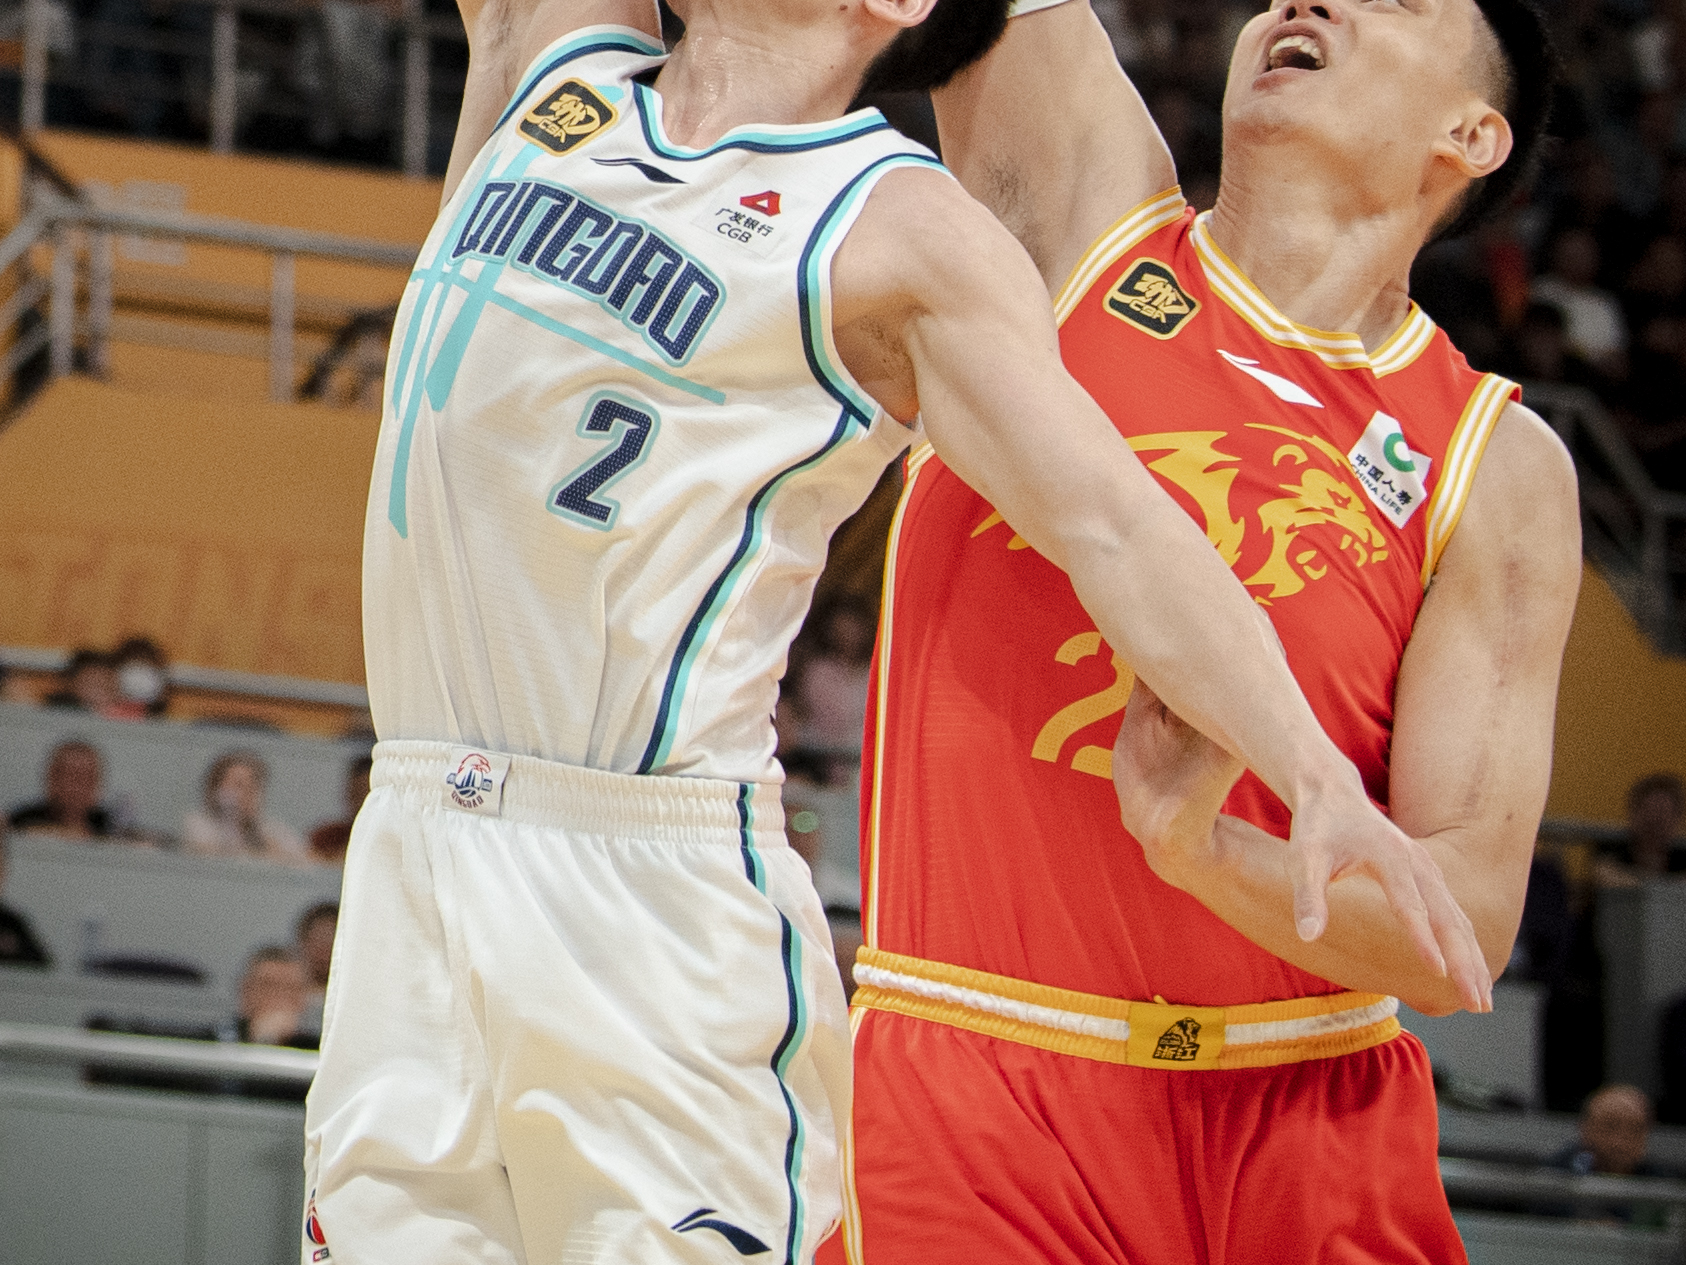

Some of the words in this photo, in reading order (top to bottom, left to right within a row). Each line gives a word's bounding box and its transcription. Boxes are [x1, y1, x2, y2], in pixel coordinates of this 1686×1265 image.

[538, 117, 567, 144] CBA
[715, 207, 774, 238] 广发银行
[716, 223, 753, 244] CGB
[452, 179, 723, 364] QINGDAO
[1129, 299, 1167, 324] CBA
[548, 392, 658, 528] 2
[1355, 453, 1413, 506] 中国人寿
[1380, 493, 1403, 515] LIFE
[1155, 1046, 1197, 1059] 浙江
[313, 1247, 330, 1262] CB
